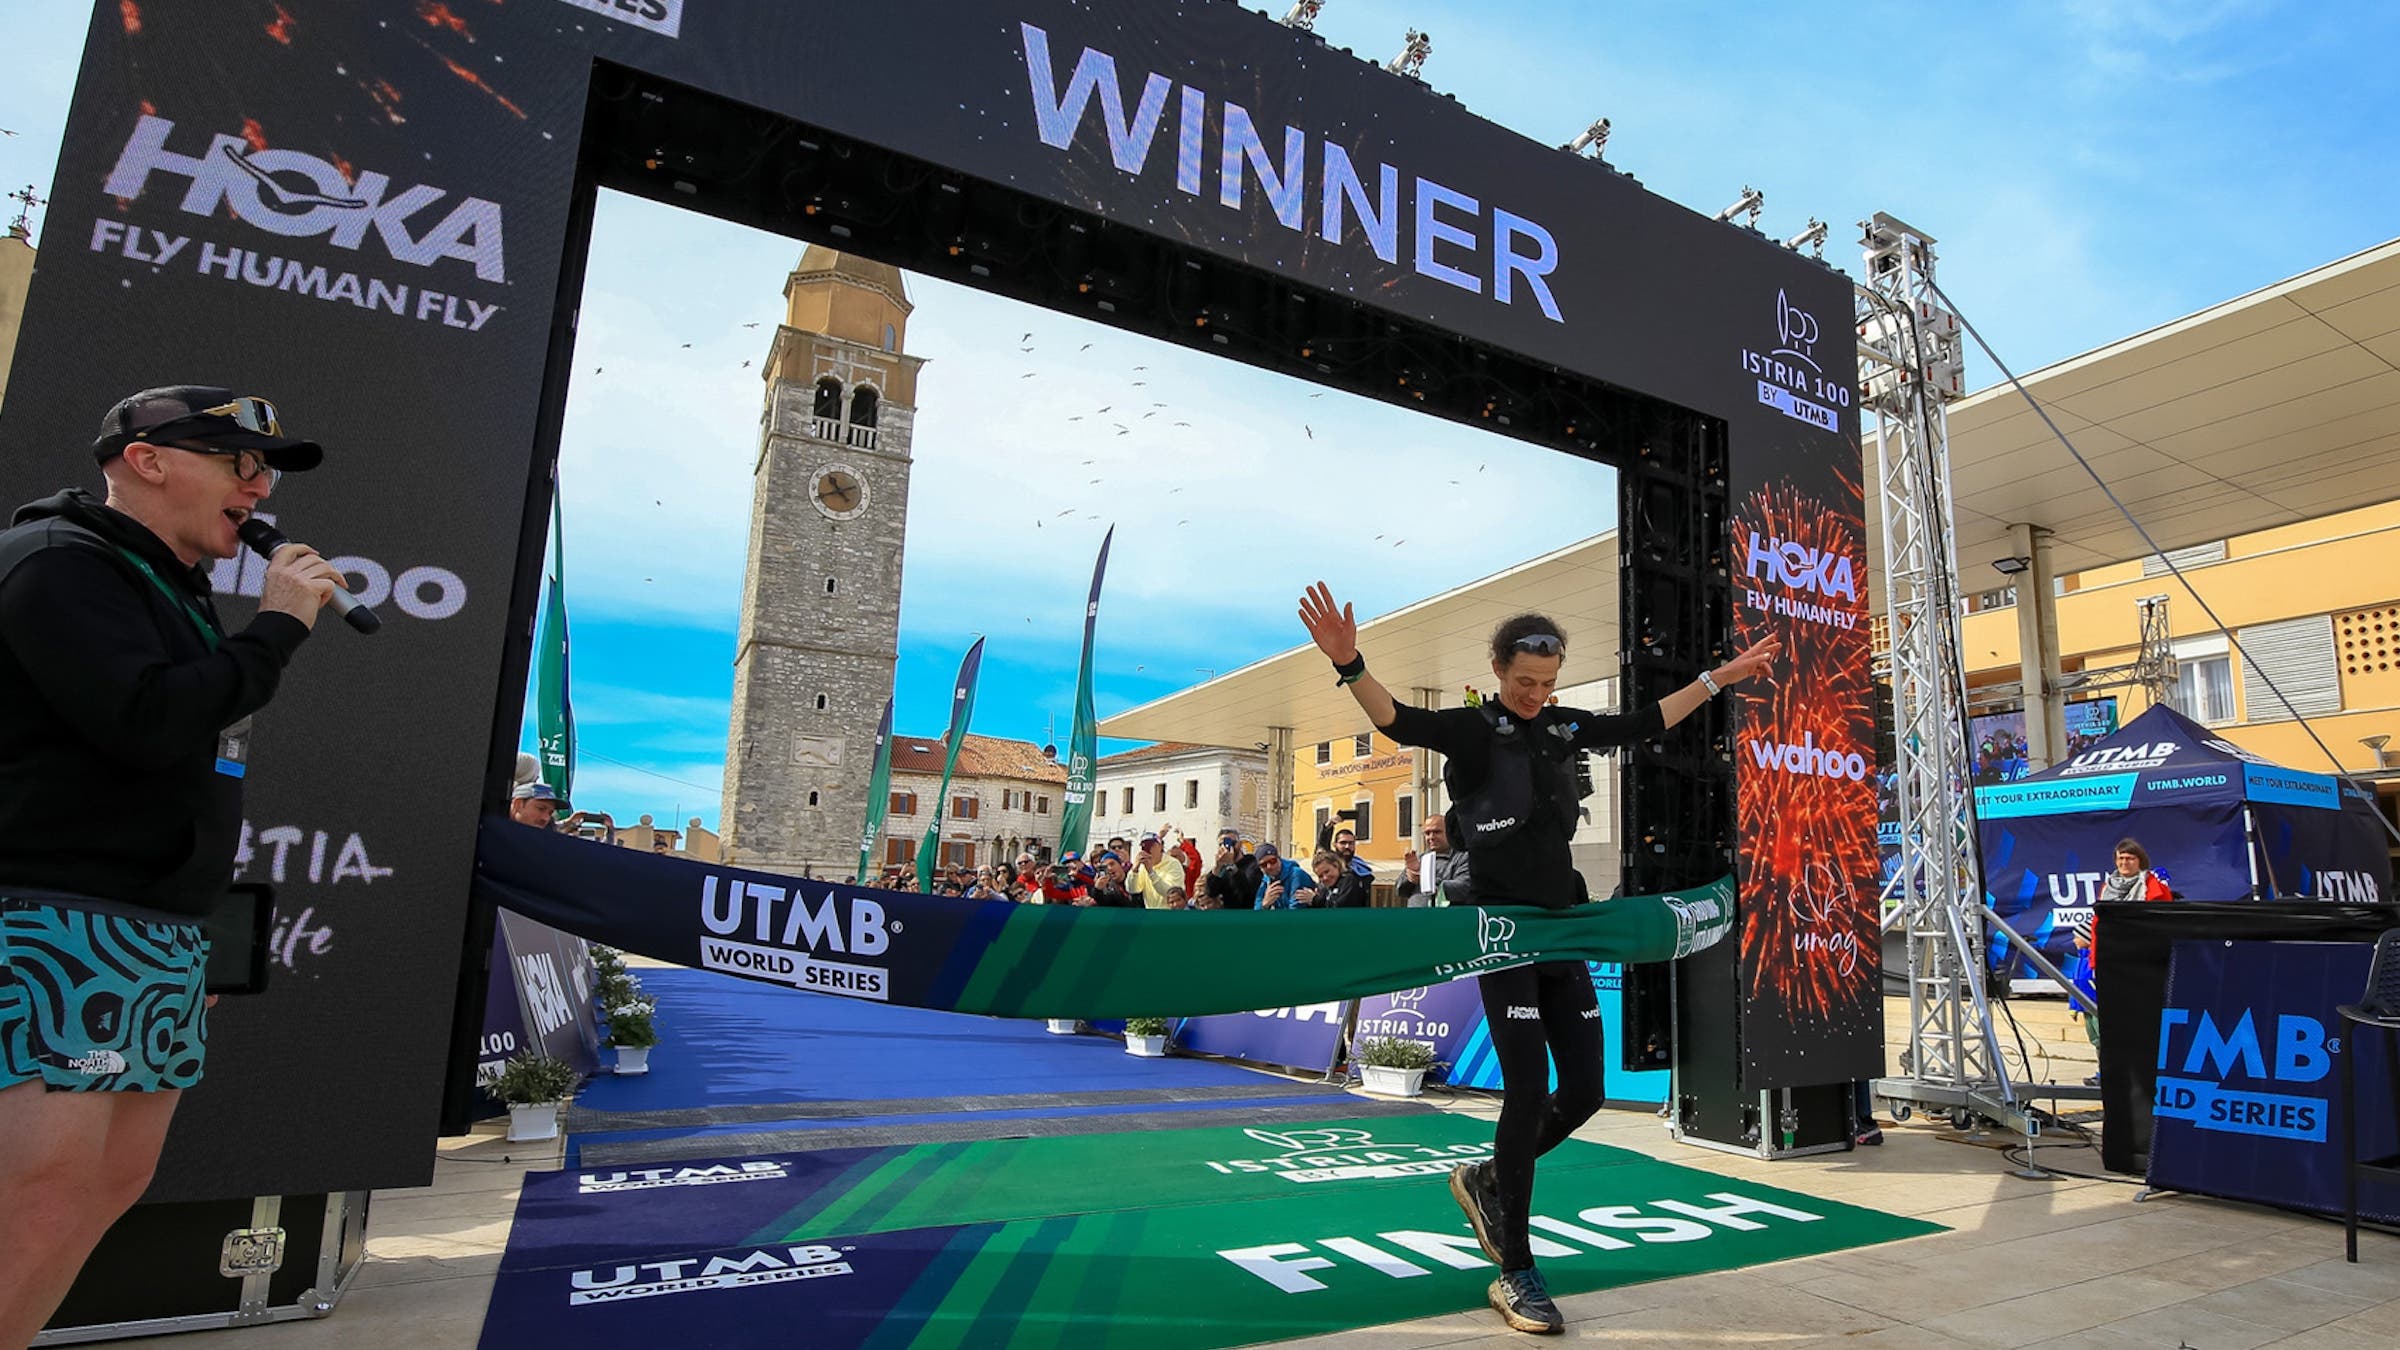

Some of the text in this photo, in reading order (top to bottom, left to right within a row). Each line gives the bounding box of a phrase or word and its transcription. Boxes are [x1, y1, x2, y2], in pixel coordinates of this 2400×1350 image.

[1021, 21, 1565, 323] WINNER
[103, 114, 506, 284] HOKA
[90, 218, 500, 332] FLY HUMAN FLY
[1742, 348, 1850, 407] ISTRIA 100
[1762, 385, 1778, 403] BY
[1747, 530, 1856, 602] HOKA
[1746, 590, 1858, 631] FLY HUMAN FLY
[1750, 731, 1866, 781] wahoo
[1976, 785, 2121, 806] EET YOUR EXTRAORDINARY
[2147, 775, 2227, 791] UTMB.WORLD
[2249, 776, 2264, 787] MEET
[1476, 816, 1516, 832] wahoo
[2048, 871, 2103, 906] UT
[270, 906, 334, 967] ife
[1794, 930, 1858, 978] umag
[708, 944, 882, 993] WORLD SERIES
[1357, 1019, 1450, 1038] ISTRIA 100
[1506, 1005, 1541, 1020] HOKA
[479, 1031, 516, 1056] 100
[2209, 1098, 2317, 1132] SERIES
[1204, 1151, 1409, 1174] ISTRIA
[591, 1178, 689, 1191] WORLD
[1215, 1191, 1826, 1294] FINISH
[584, 1264, 843, 1300] WORLD SERIES
